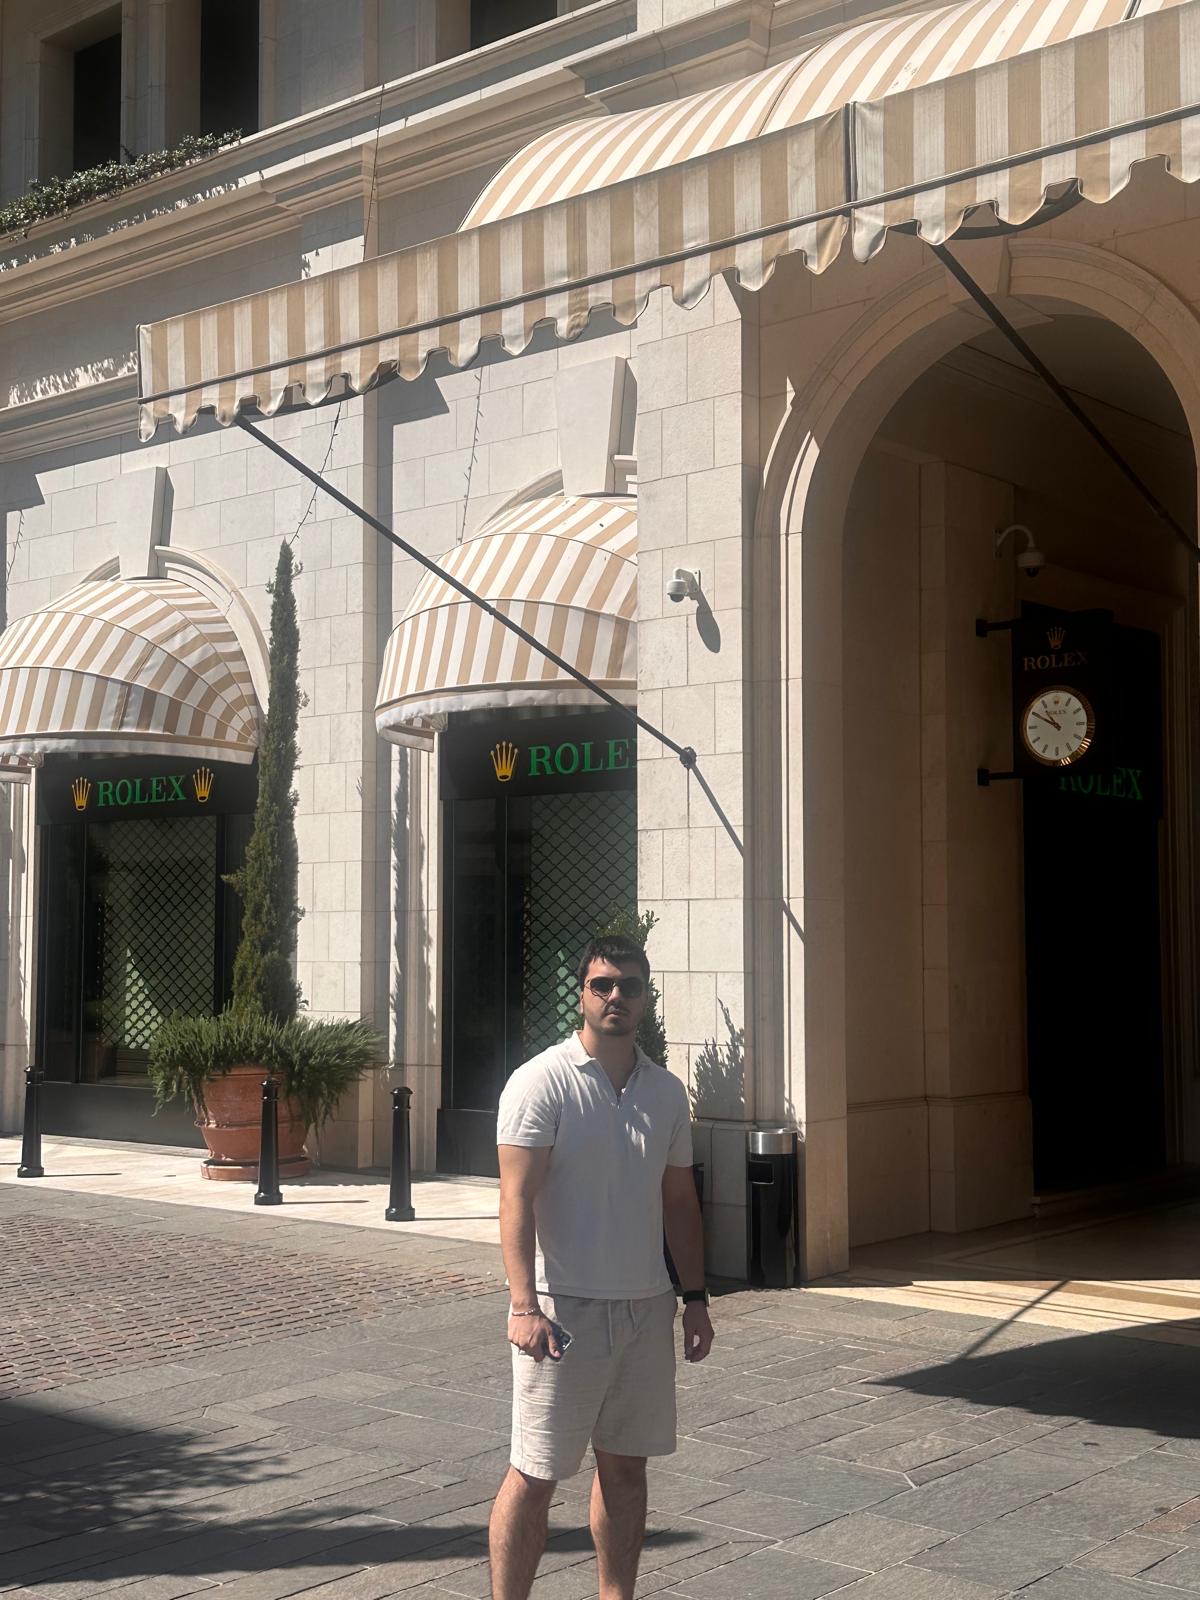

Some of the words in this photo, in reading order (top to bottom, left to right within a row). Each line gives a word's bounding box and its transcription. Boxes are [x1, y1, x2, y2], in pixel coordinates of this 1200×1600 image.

[1023, 652, 1089, 671] ROLEX
[527, 738, 638, 776] ROLE
[97, 775, 187, 807] ROLEX
